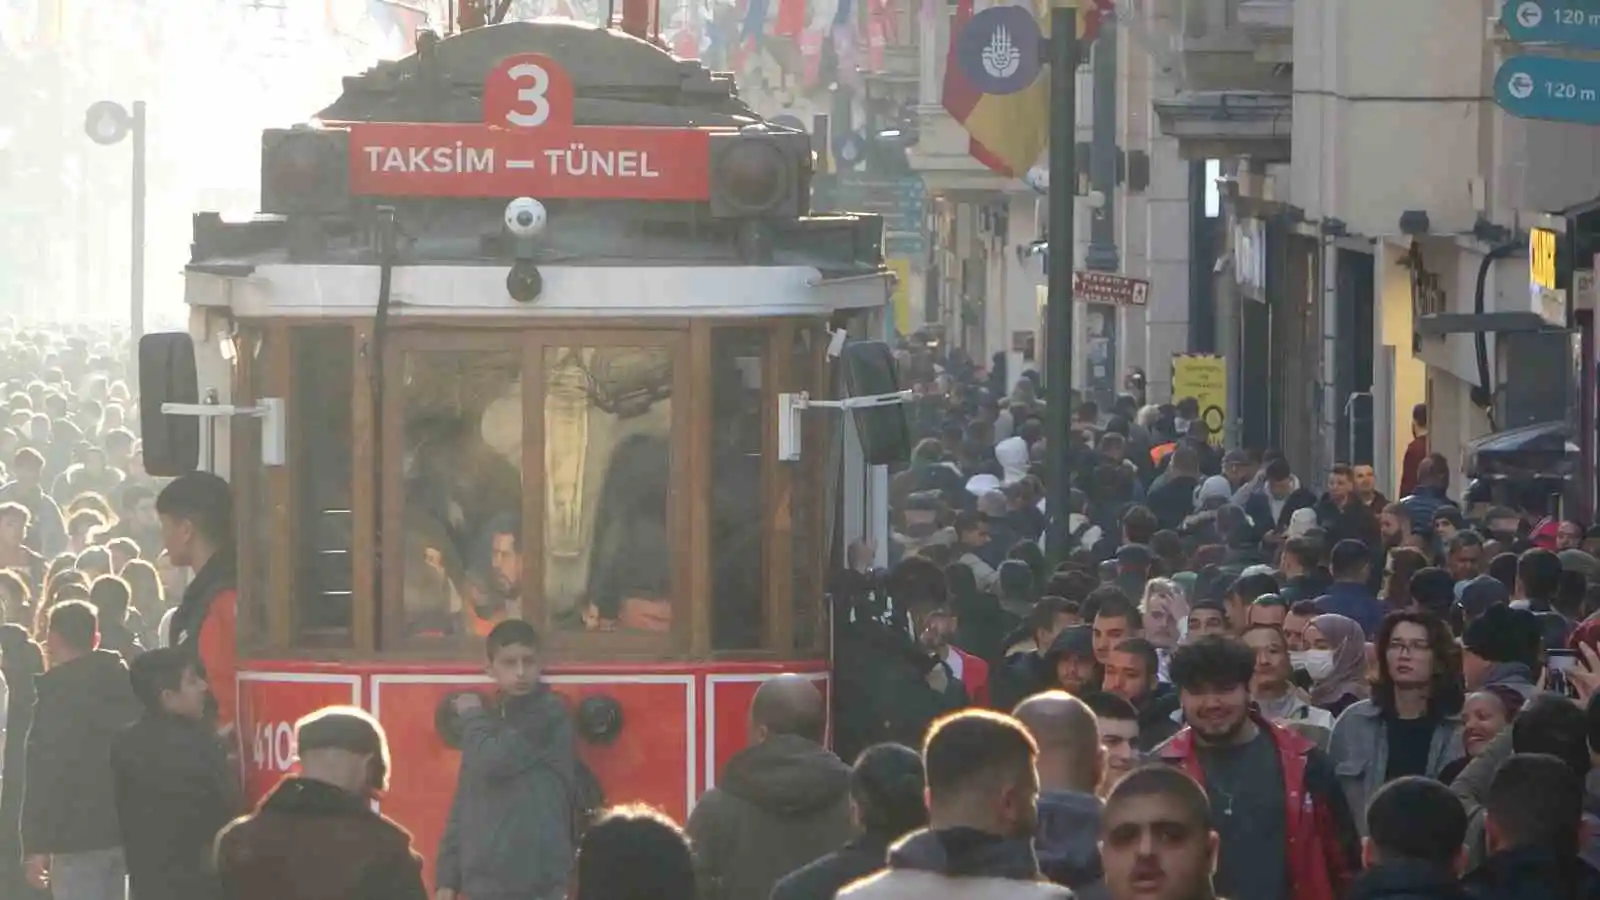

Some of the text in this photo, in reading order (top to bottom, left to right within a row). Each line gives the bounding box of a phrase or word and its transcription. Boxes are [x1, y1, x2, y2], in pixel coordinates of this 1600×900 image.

[1552, 7, 1585, 25] 120
[504, 63, 550, 127] 3
[1544, 81, 1596, 101] 120 m
[362, 140, 495, 174] TAKSİM
[543, 143, 660, 178] TÜNEL
